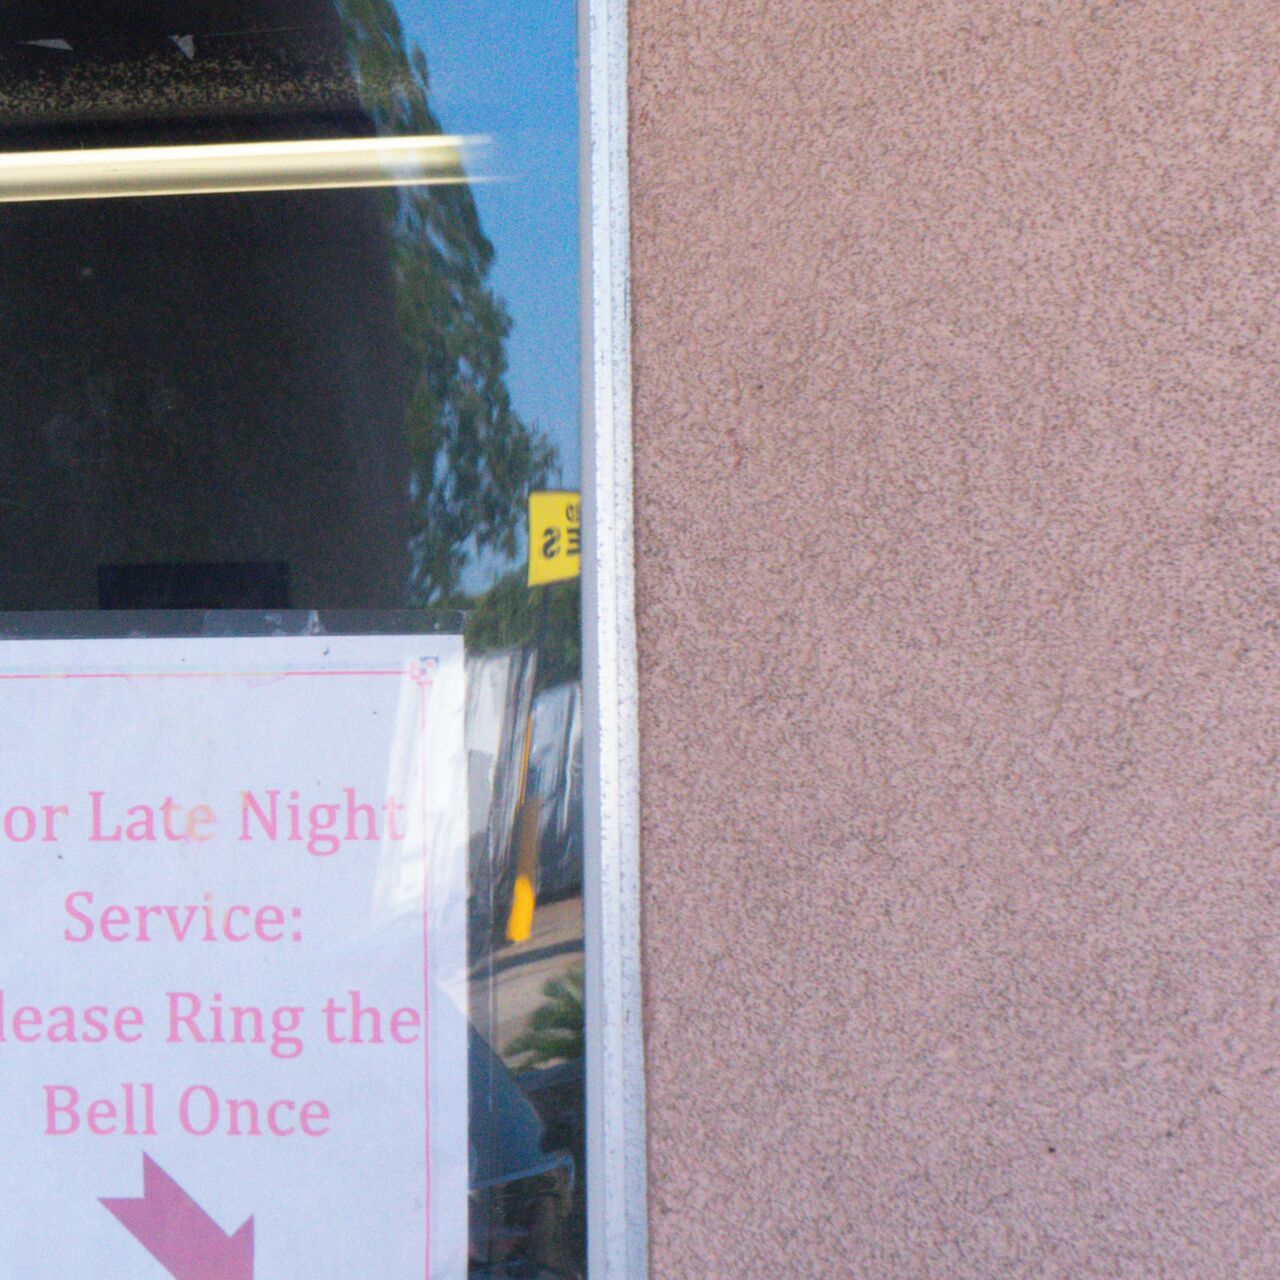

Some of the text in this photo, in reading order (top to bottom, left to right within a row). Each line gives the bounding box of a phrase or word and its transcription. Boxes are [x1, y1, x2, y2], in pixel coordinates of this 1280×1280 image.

[88, 791, 217, 843] Late
[238, 787, 408, 856] Night
[64, 891, 304, 943] Service:
[165, 991, 305, 1059] Ring
[325, 990, 422, 1044] the
[42, 1083, 332, 1138] Bell Once
